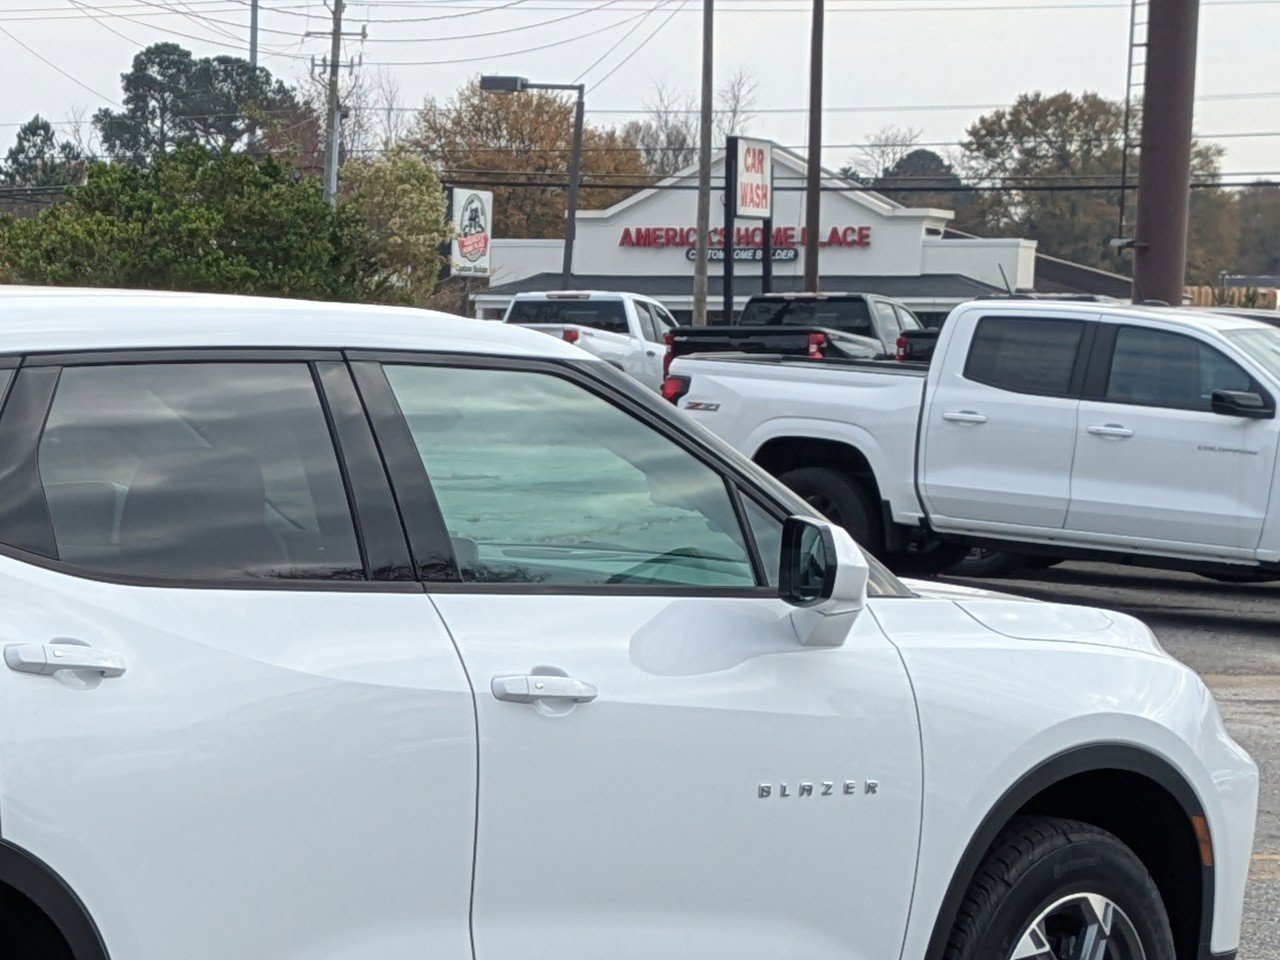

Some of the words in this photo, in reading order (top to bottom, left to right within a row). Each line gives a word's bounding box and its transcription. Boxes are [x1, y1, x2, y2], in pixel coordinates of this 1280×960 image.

[744, 147, 765, 174] CAR
[740, 182, 768, 209] WASH
[735, 227, 795, 246] HOME
[688, 249, 726, 259] CTOM
[731, 249, 754, 259] OME
[758, 780, 878, 798] BLAZER
